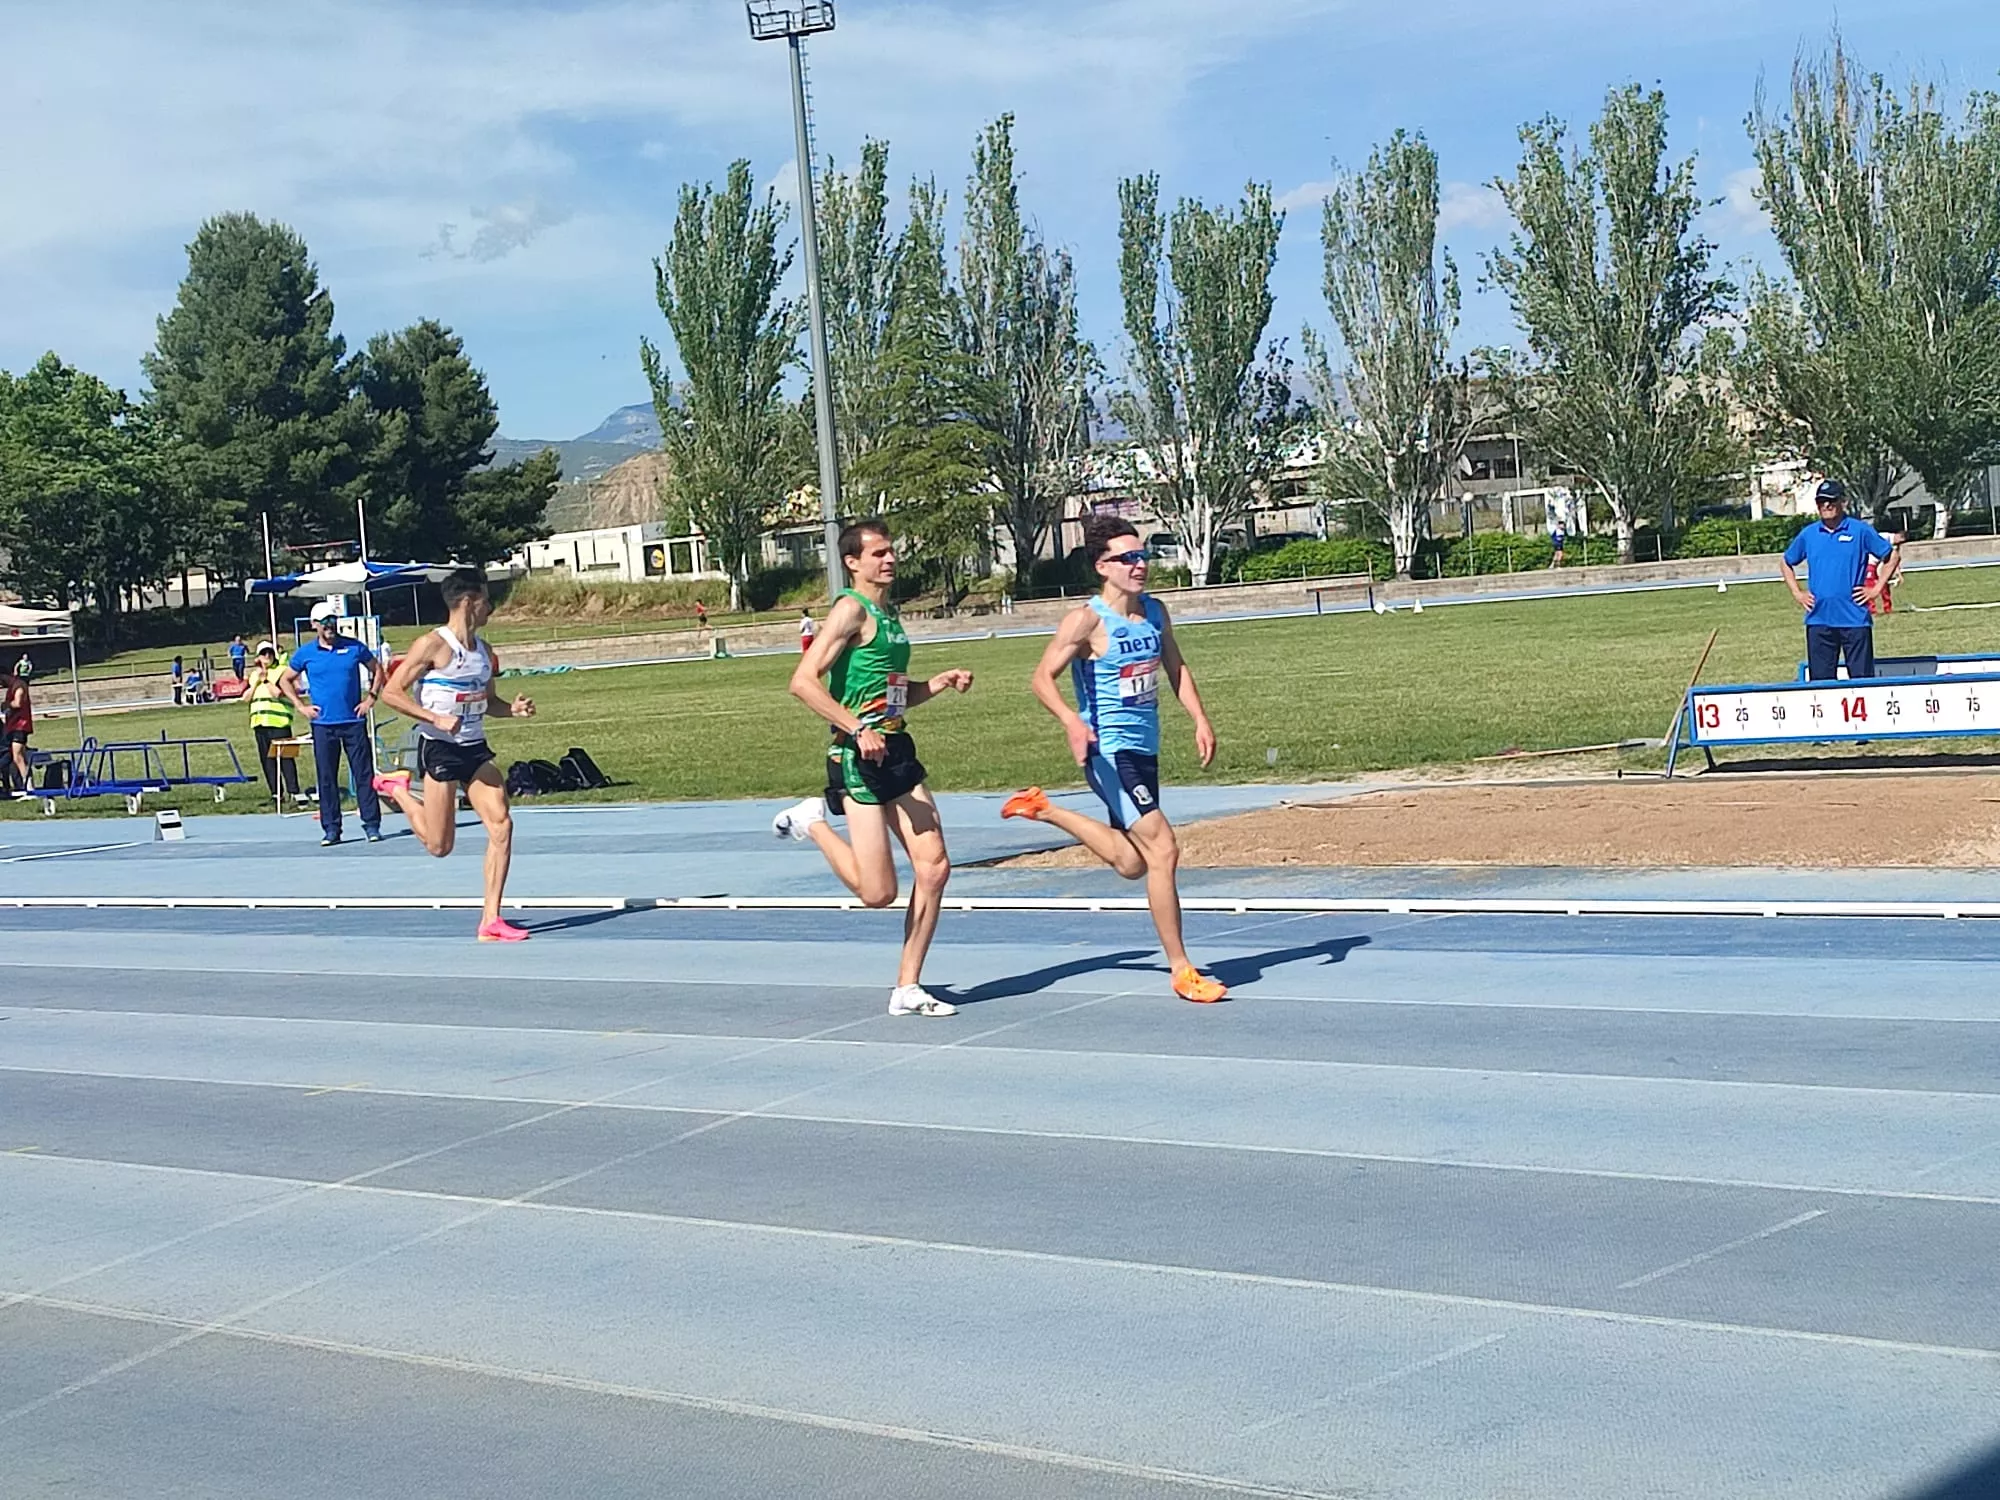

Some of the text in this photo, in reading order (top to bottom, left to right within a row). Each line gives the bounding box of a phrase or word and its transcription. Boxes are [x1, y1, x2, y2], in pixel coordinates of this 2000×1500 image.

[1118, 630, 1160, 654] nerj
[1697, 697, 1981, 728] 13 25 50 75 14 25 50 75
